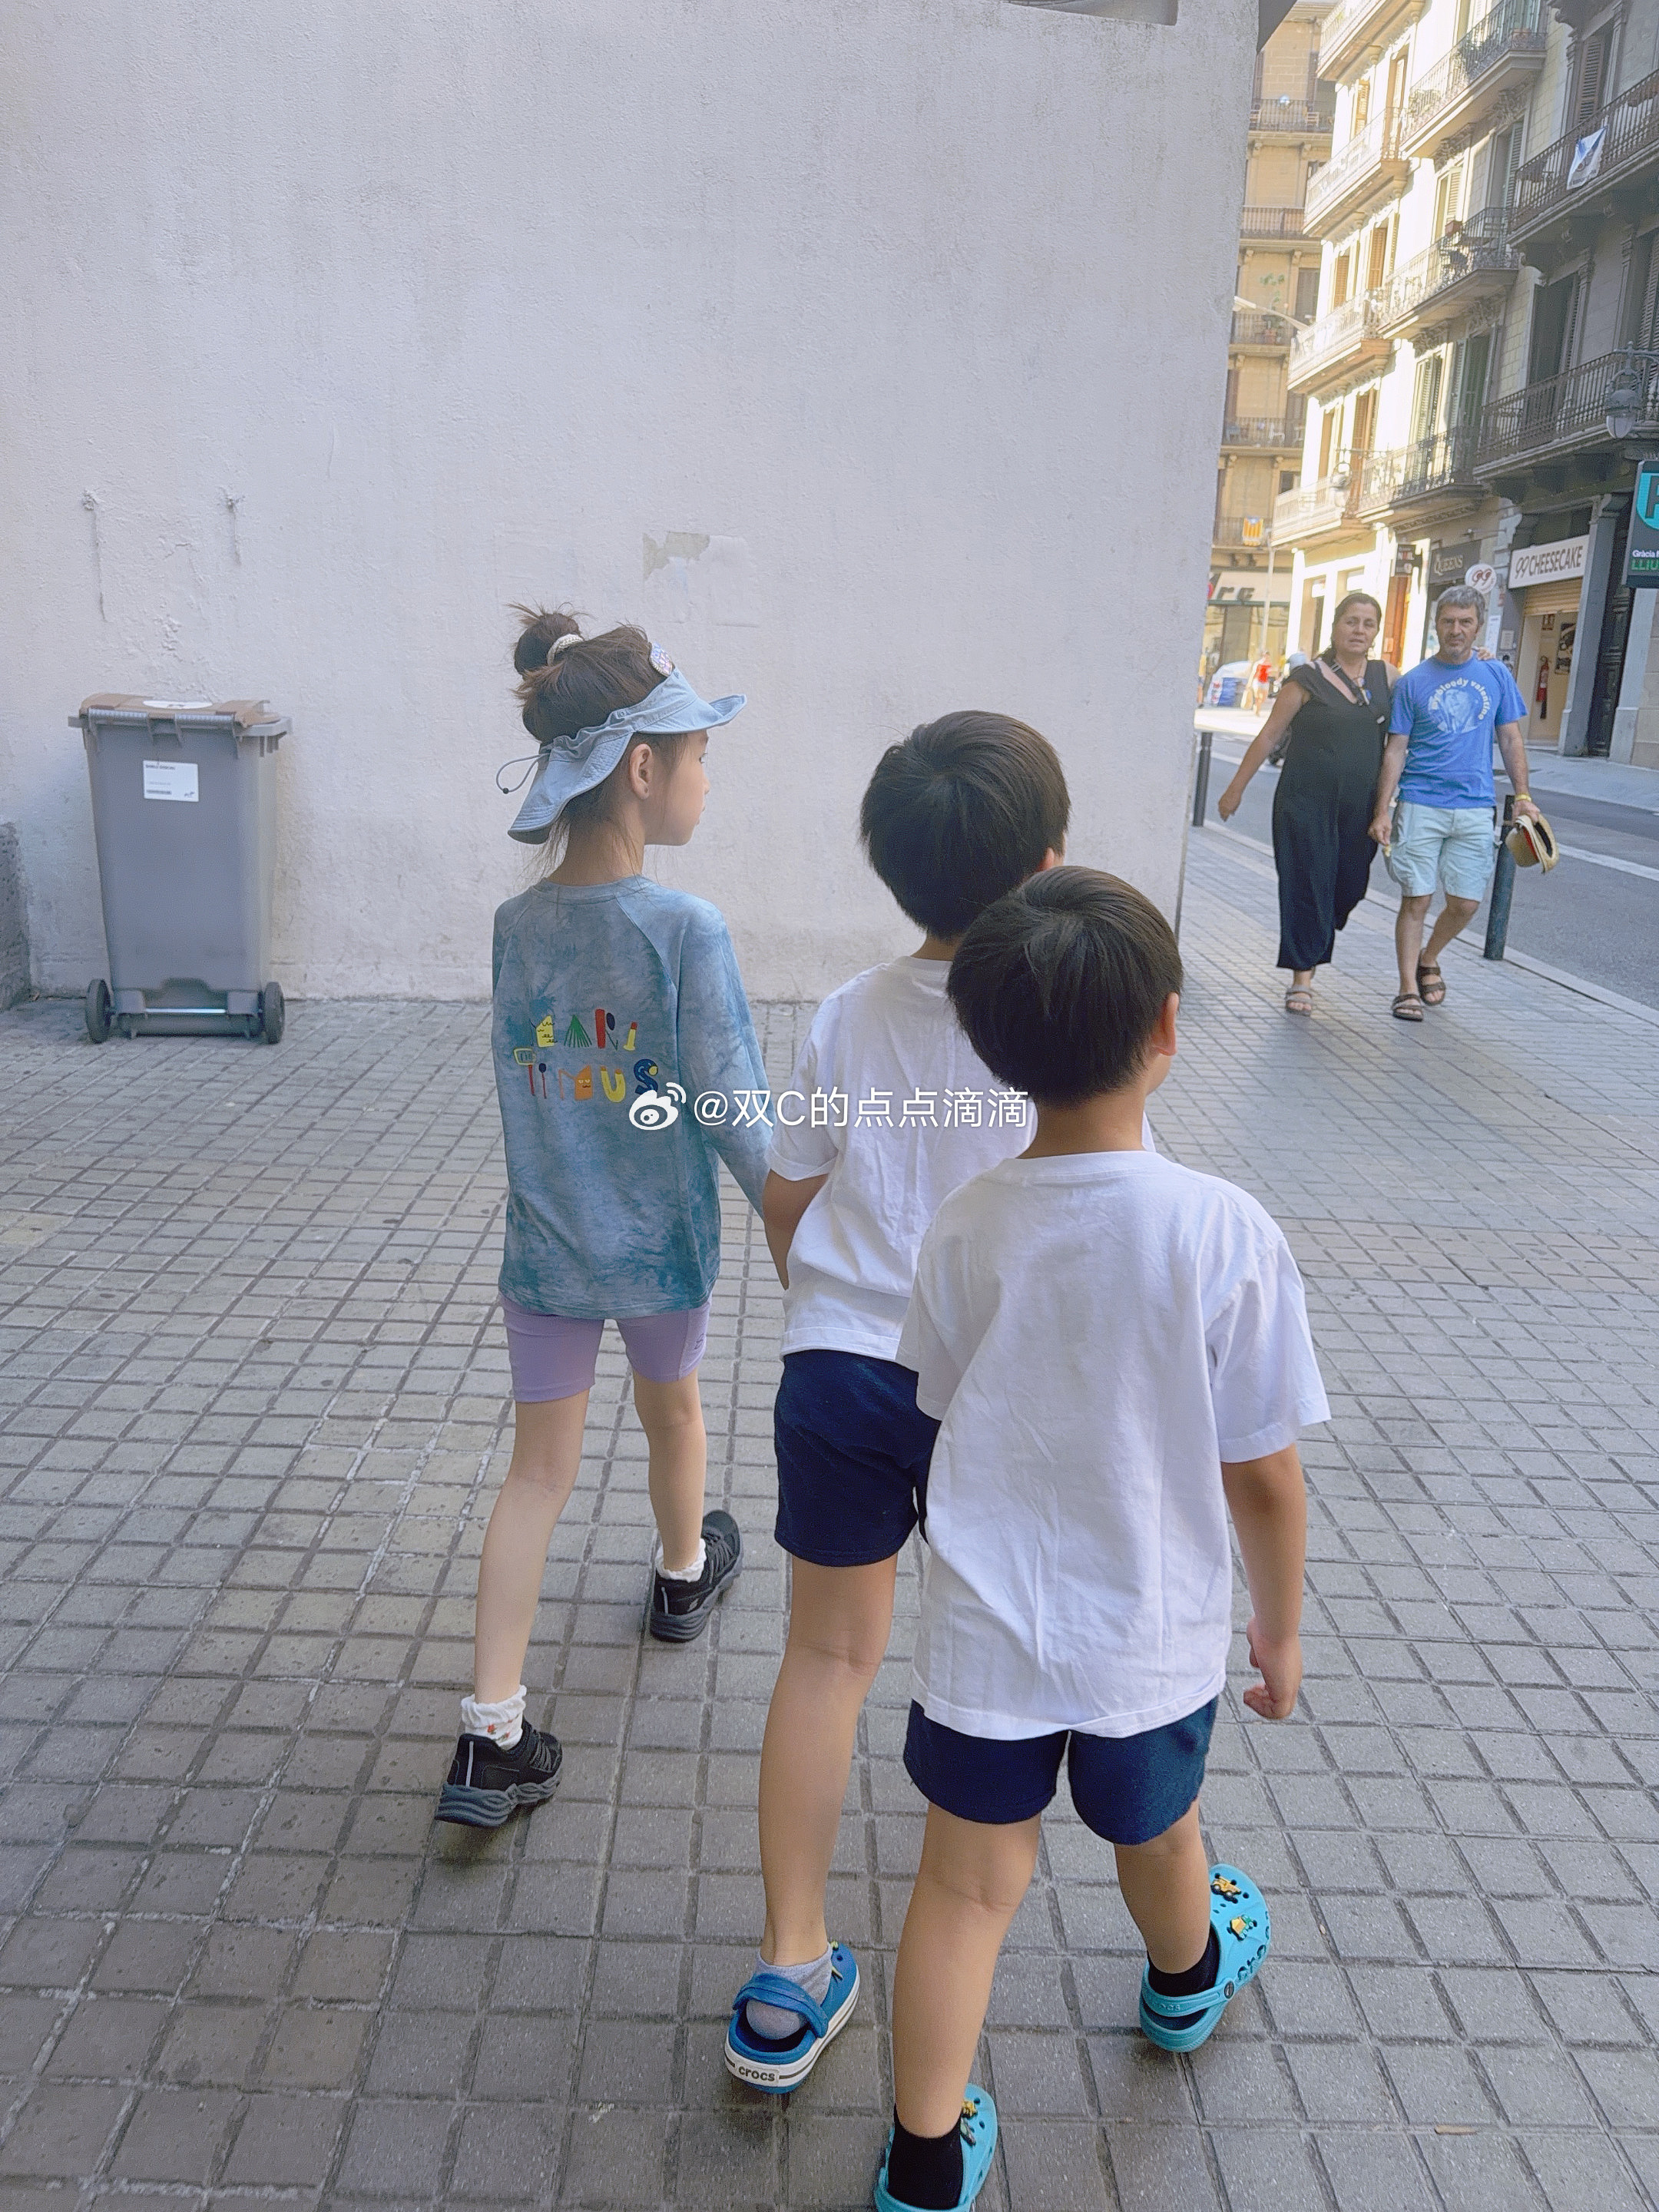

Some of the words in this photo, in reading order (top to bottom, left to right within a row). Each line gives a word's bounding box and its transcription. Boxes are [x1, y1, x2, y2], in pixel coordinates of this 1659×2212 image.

[1529, 545, 1584, 576] CHEESECAKE
[1632, 549, 1655, 558] Gràcia
[1435, 677, 1469, 695] bloody
[1471, 680, 1490, 720] valentine
[738, 2065, 775, 2081] crocs
